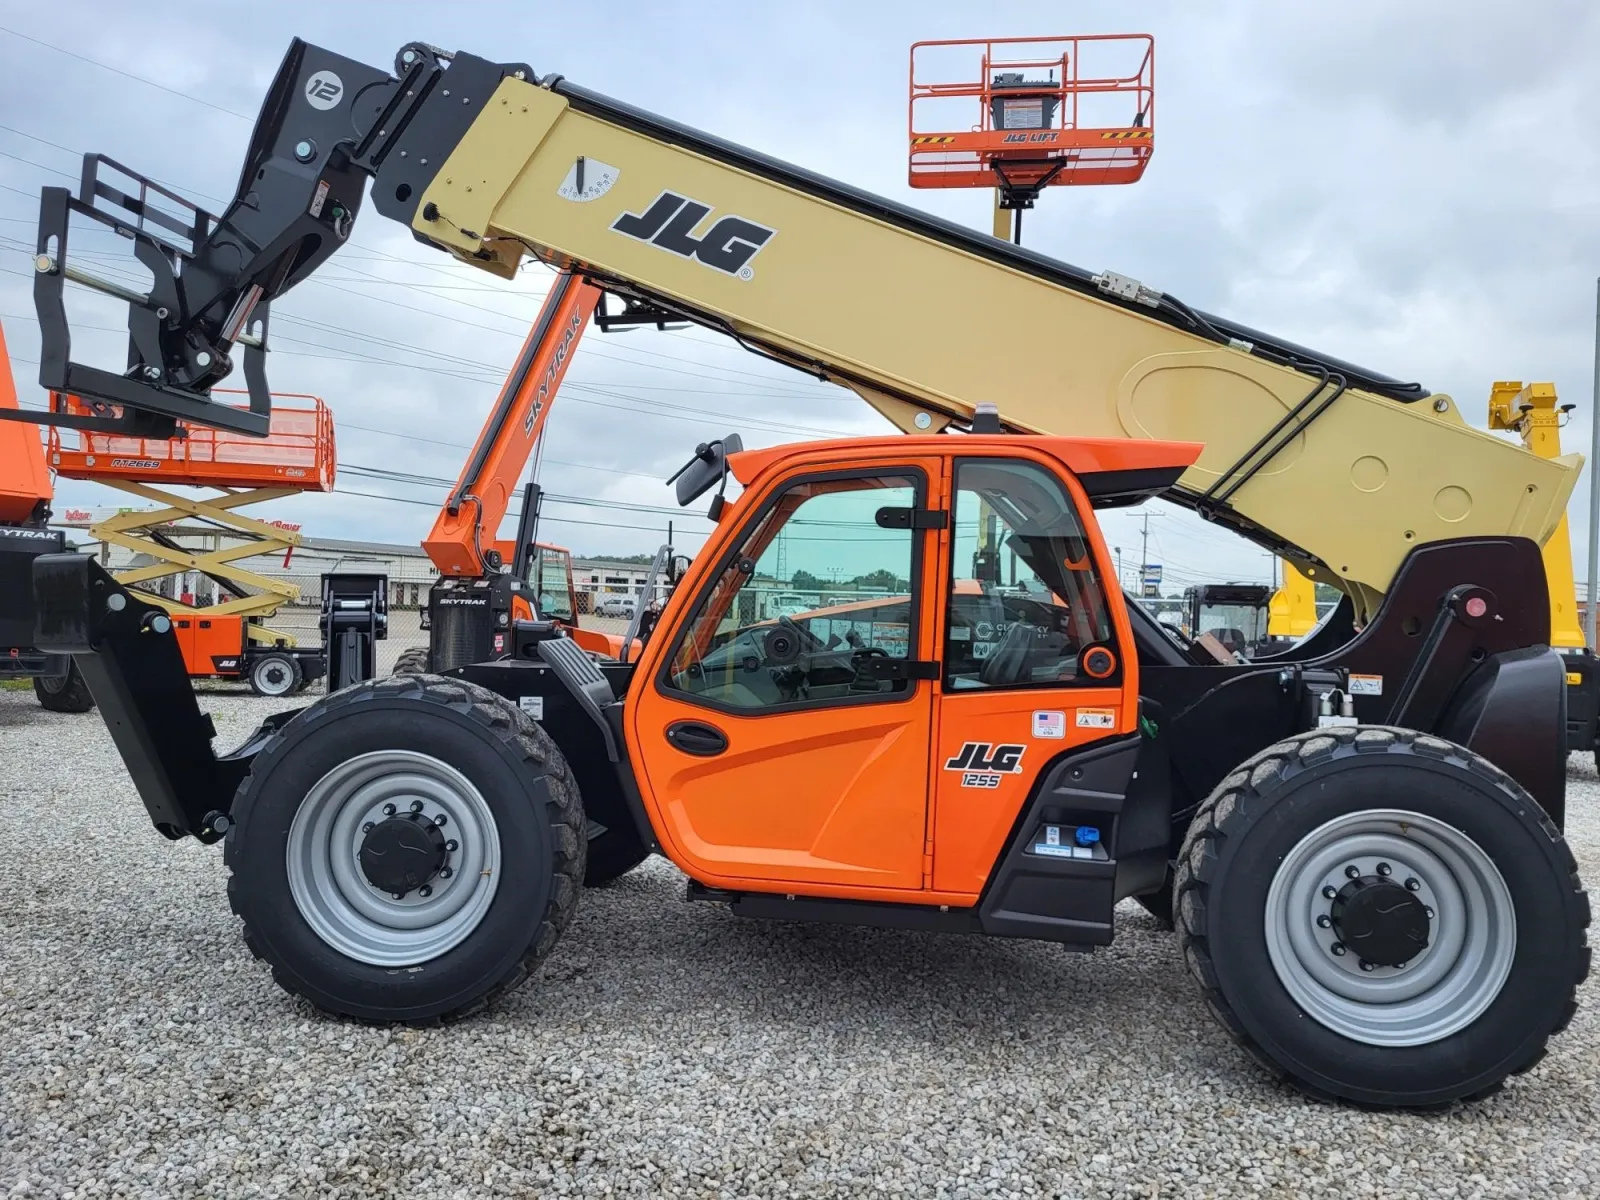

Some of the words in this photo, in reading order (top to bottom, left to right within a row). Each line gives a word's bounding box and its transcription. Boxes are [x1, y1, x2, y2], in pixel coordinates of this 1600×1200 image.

[308, 79, 342, 102] 12
[1002, 133, 1027, 143] JLG
[1029, 132, 1060, 143] LIFT
[611, 190, 776, 276] JLG
[524, 304, 581, 439] SKYTRAK
[110, 458, 161, 469] RT2669
[439, 598, 487, 606] SKYTRAK
[945, 742, 1027, 773] JLG
[962, 773, 1001, 788] 1255
